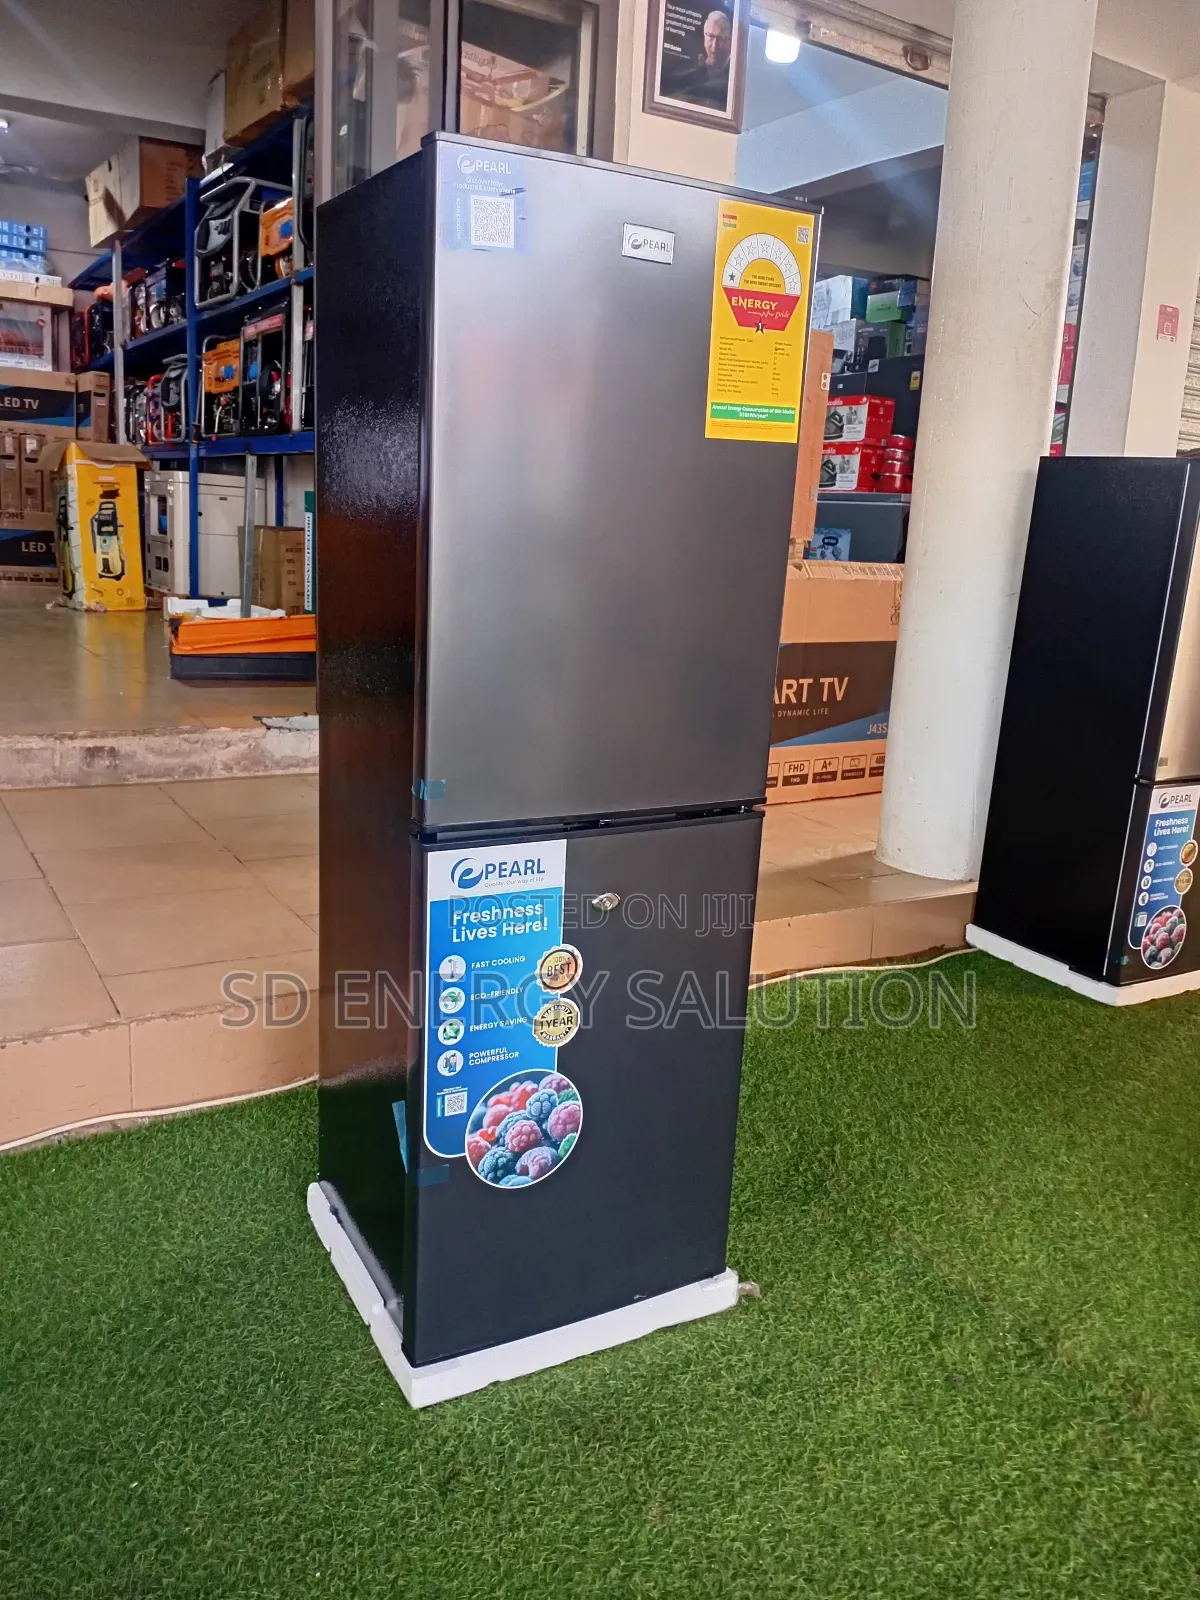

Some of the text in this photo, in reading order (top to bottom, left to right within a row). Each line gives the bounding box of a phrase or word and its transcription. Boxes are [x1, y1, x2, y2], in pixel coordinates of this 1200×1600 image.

[732, 295, 778, 310] ENERGY
[758, 322, 762, 330] 1
[23, 399, 39, 409] TV
[21, 541, 47, 552] LED
[820, 677, 849, 702] TV
[778, 707, 829, 717] DYNAMIC LIFE
[788, 763, 805, 773] FHD
[821, 760, 832, 770] A+
[1155, 818, 1188, 827] Freshness
[1153, 825, 1189, 836] Lives Here!
[485, 858, 545, 880] PEARL
[453, 903, 543, 925] Freshness
[452, 917, 548, 943] Lives Here!
[471, 955, 526, 969] FAST COOLING
[547, 963, 571, 976] BEST
[471, 987, 524, 1001] ECO-FRIENDLY
[542, 1004, 572, 1018] WARRANTY
[469, 1017, 527, 1032] ENERGY SAVING
[546, 1016, 573, 1029] YEAR
[542, 1028, 571, 1041] WARRANTY
[469, 1047, 508, 1059] POWERFUL
[469, 1052, 519, 1066] COMPRESSOR
